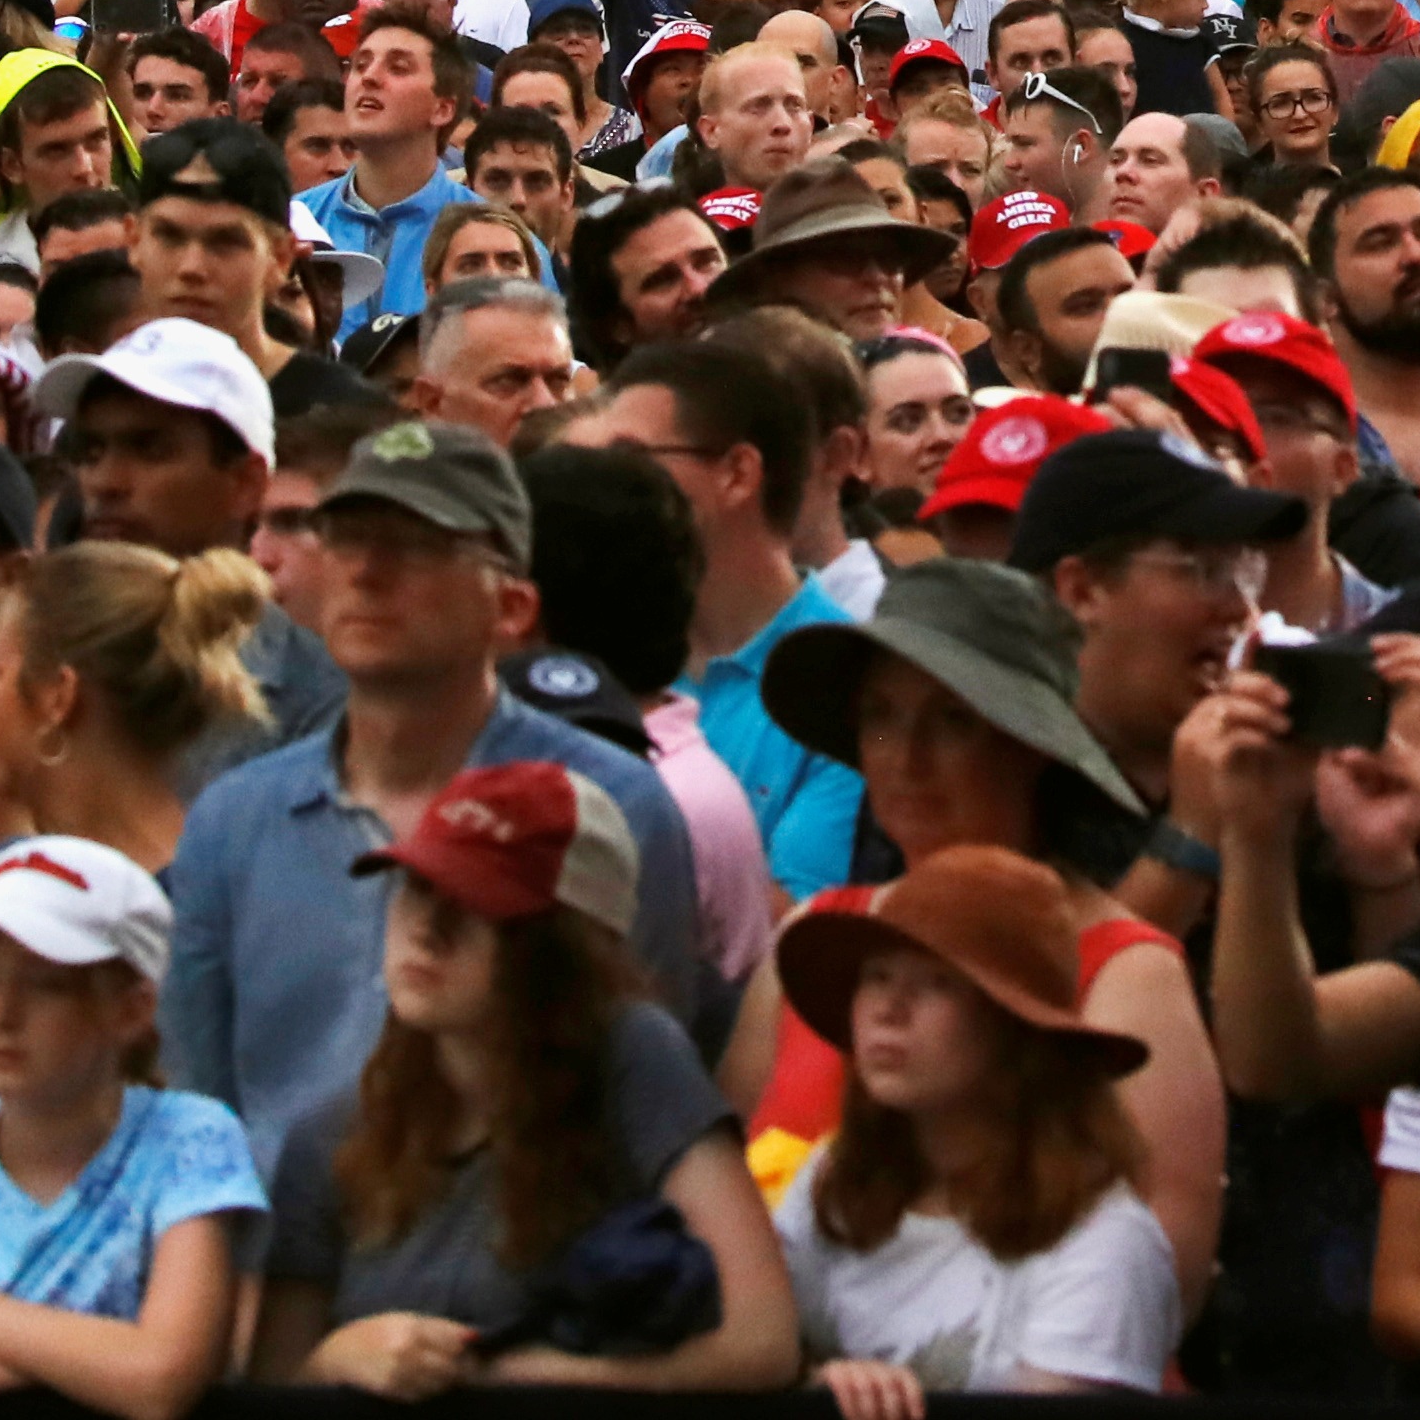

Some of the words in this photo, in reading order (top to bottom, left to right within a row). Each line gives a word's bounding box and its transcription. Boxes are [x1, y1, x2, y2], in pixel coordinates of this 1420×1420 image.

[702, 197, 761, 214] AMERICA
[1003, 191, 1038, 206] KEEP
[706, 206, 751, 222] GREAT
[996, 202, 1056, 223] AMERICA
[1008, 213, 1051, 229] GREAT
